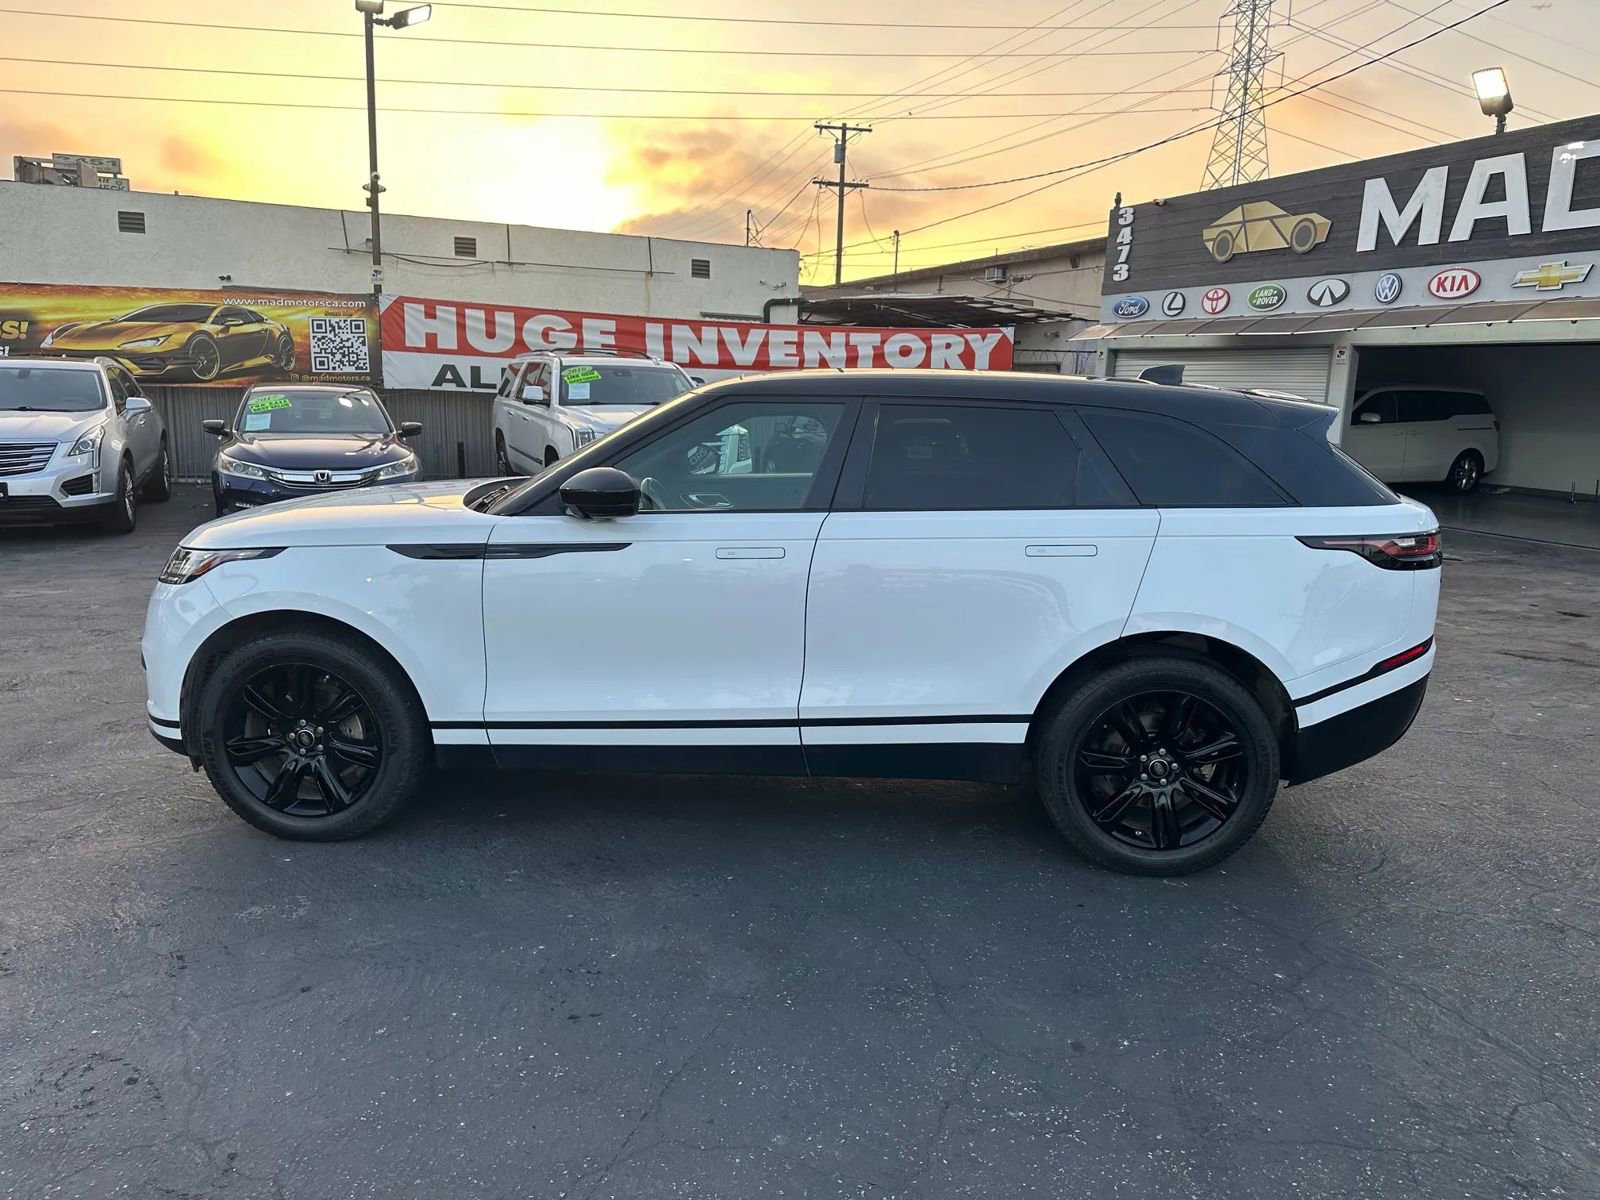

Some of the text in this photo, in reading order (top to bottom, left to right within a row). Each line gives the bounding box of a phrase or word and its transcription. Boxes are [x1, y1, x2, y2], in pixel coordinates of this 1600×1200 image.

[1112, 207, 1134, 282] 3473
[1435, 275, 1469, 293] KIA
[1255, 288, 1274, 298] LAND
[1256, 296, 1278, 305] ROVER
[223, 298, 366, 308] www.madmotorsca.com
[1118, 300, 1141, 315] Ford
[404, 303, 1003, 370] HUGE INVENTORY
[301, 374, 371, 382] @madmotors.ca
[431, 363, 507, 390] AL
